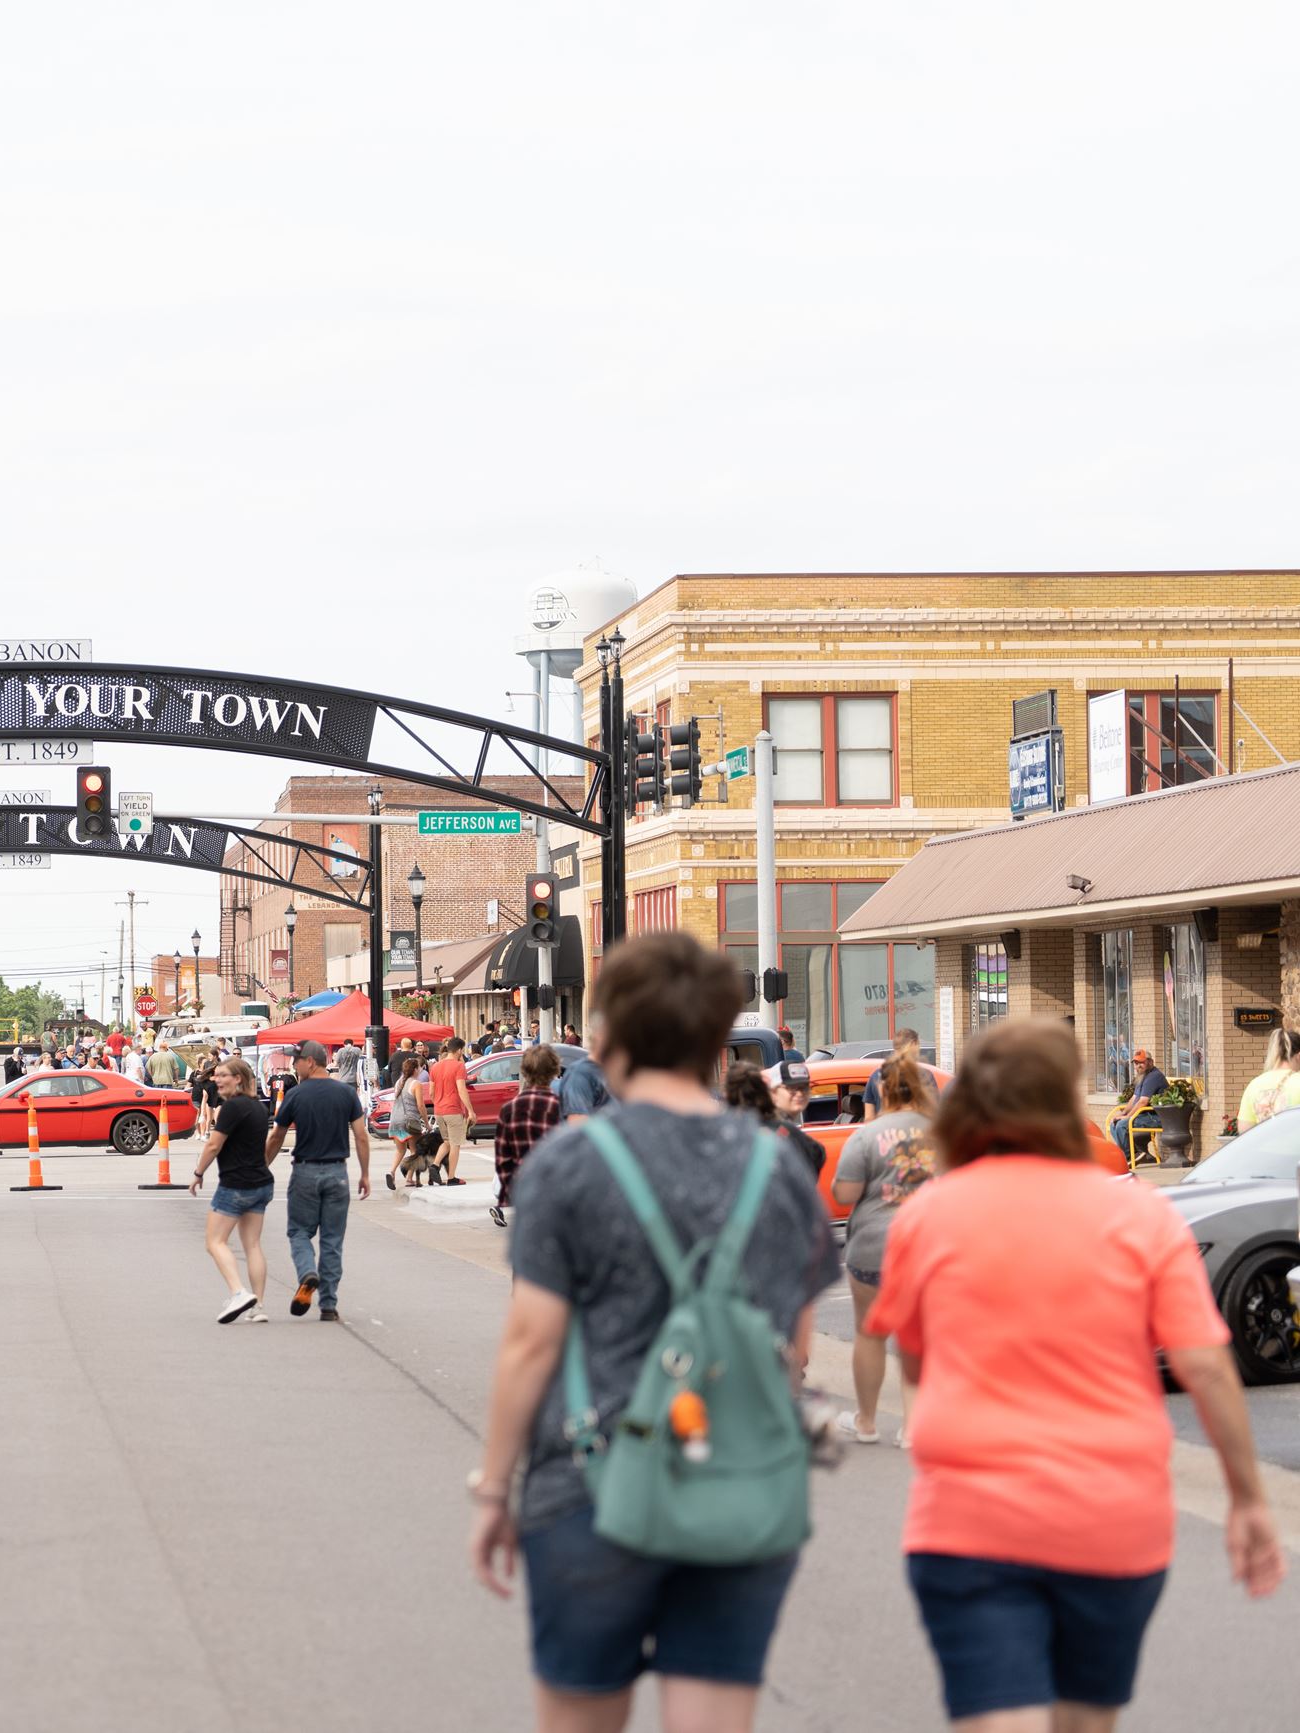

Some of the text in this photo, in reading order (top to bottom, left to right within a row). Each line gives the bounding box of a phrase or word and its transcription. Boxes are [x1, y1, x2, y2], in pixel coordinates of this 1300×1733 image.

[24, 683, 155, 721] YOUR
[183, 690, 329, 740] TOWN
[30, 742, 79, 760] 1849
[123, 802, 148, 810] YIELD
[422, 816, 517, 830] JEFFERSON AVE
[12, 854, 42, 867] 1849
[137, 1002, 156, 1011] STOP
